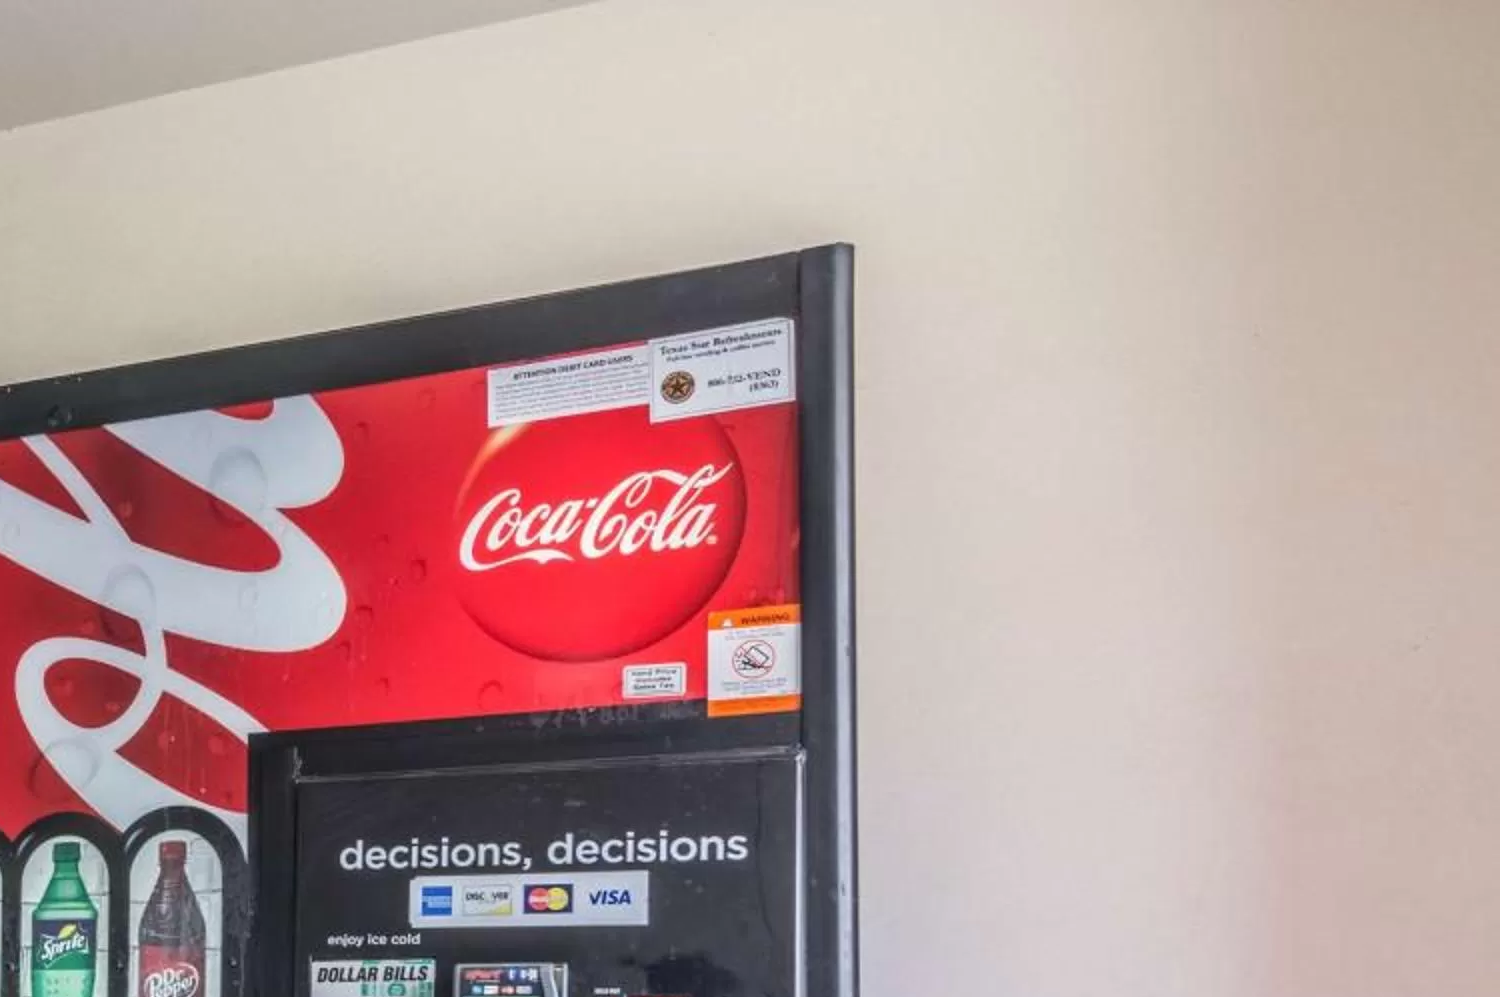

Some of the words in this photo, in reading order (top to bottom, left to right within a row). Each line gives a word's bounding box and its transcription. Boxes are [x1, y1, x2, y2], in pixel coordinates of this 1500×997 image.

[513, 367, 557, 380] ATTENTION
[558, 362, 581, 373] DEBIT
[583, 359, 607, 369] CARD
[608, 355, 633, 365] USERS
[459, 461, 734, 572] Coca-Cola
[740, 612, 790, 625] WARNING
[339, 837, 532, 871] decisions,
[546, 829, 748, 865] decisions
[589, 889, 632, 905] VISA
[41, 931, 85, 961] Sprite
[327, 933, 364, 948] enjoy
[367, 933, 388, 945] ice
[391, 933, 421, 945] cold
[164, 967, 184, 982] Dr
[317, 967, 379, 982] DOLLAR
[383, 965, 429, 981] BILLS
